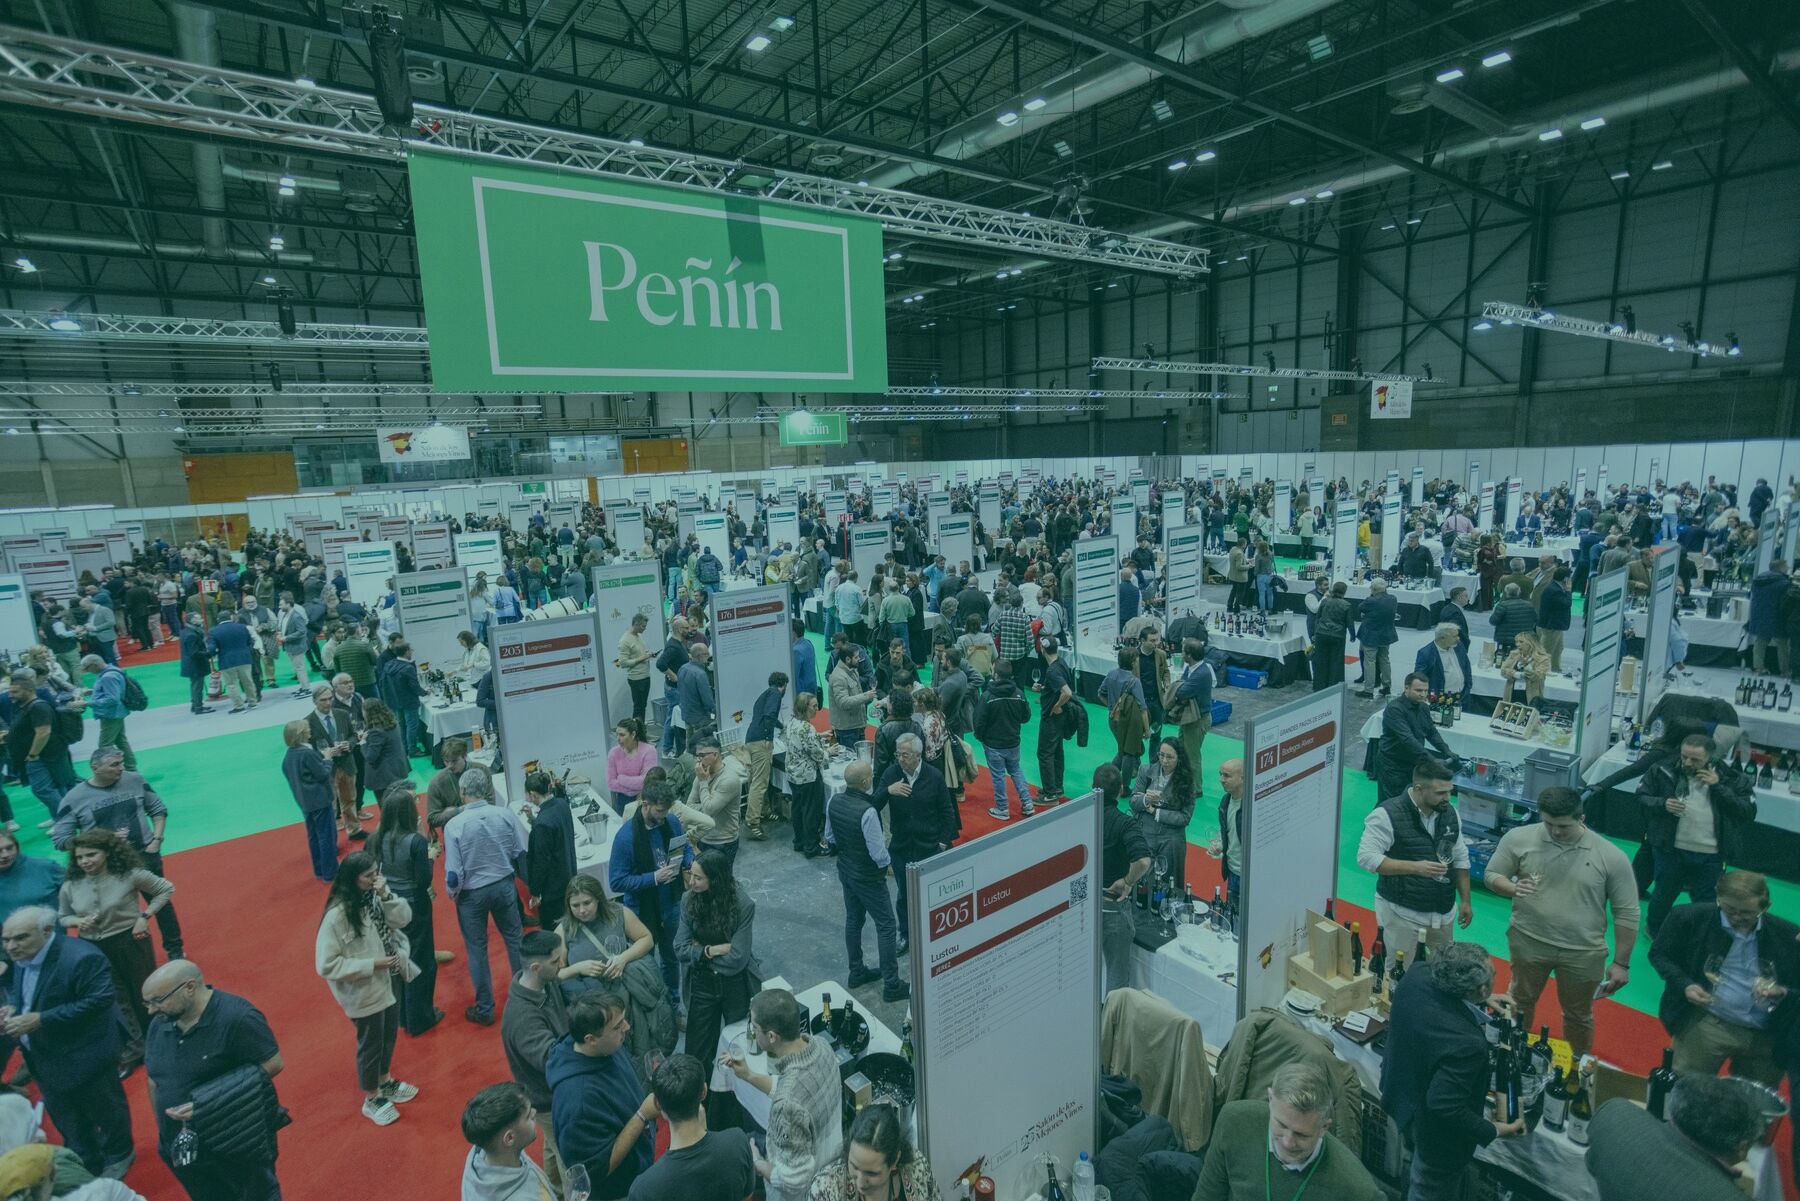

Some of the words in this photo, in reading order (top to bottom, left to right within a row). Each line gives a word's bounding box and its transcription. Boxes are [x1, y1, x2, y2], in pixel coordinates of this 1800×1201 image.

[583, 241, 782, 330] Peñín
[1261, 751, 1273, 769] 174
[938, 878, 964, 897] Peñín
[935, 901, 969, 934] 205
[983, 889, 1011, 907] Lustau
[931, 944, 960, 963] Lustau
[935, 962, 951, 974] JEREZ
[1035, 1110, 1055, 1131] Salón
[1065, 1099, 1076, 1110] los
[1036, 1118, 1063, 1142] Mejores
[1064, 1104, 1084, 1121] Vinos
